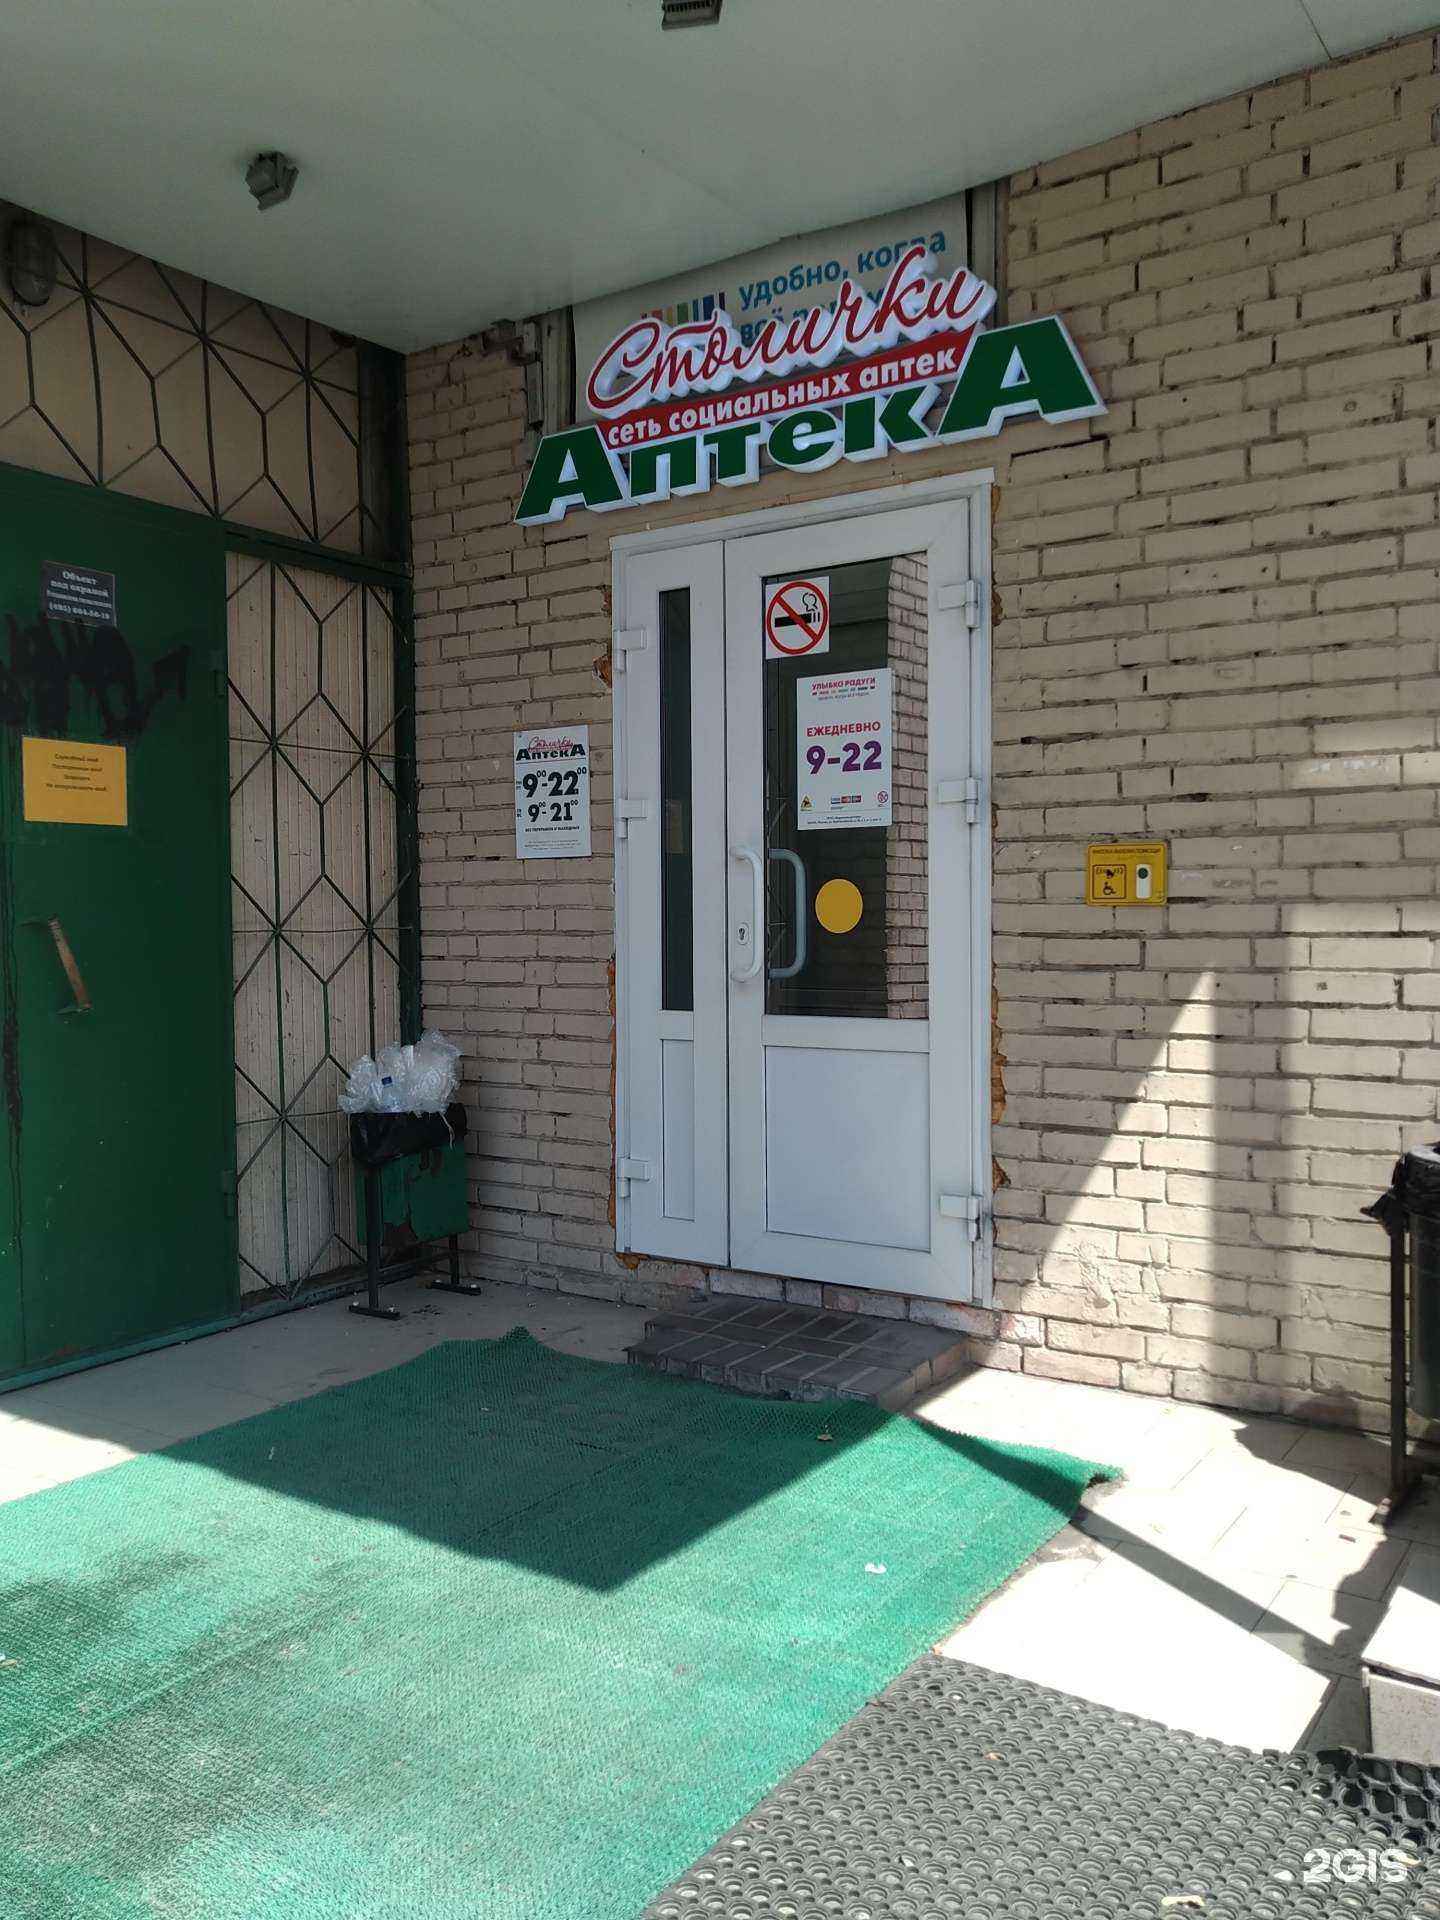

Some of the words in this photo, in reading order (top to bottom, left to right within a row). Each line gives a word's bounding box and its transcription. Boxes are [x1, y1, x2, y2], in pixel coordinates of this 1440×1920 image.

[739, 260, 849, 311] удобно,
[587, 245, 988, 405] Столички
[607, 414, 662, 447] сеть
[668, 372, 851, 432] социальных
[859, 345, 958, 391] аптек
[806, 721, 881, 737] ЕЖЕДНЕВНО
[806, 740, 882, 775] 9-22
